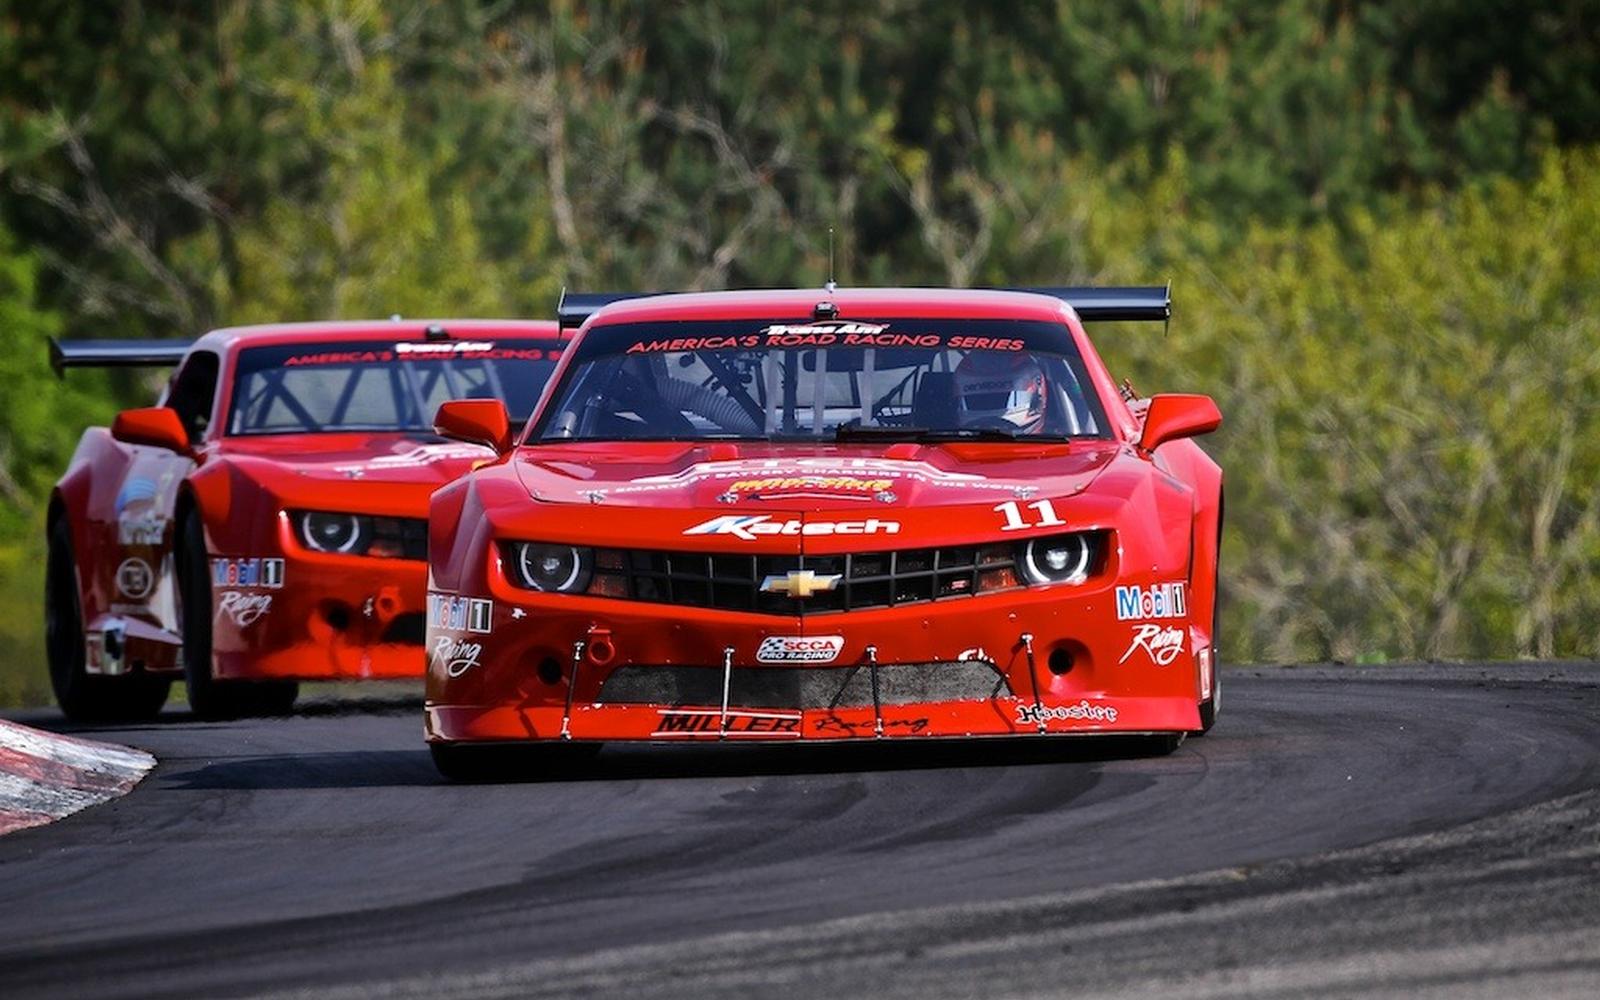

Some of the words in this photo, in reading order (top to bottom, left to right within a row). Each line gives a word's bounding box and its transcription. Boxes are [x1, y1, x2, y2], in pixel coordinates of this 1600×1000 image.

[766, 324, 836, 335] Trans
[836, 323, 886, 334] Am
[626, 335, 760, 353] AMERICA'S
[766, 334, 837, 347] ROAD
[843, 334, 940, 347] RACING
[947, 335, 1025, 351] SERIES
[994, 498, 1066, 531] 11
[683, 514, 900, 541] Katech
[1116, 584, 1172, 620] Mobil
[784, 640, 836, 651] SCCA
[761, 651, 785, 659] PRO
[786, 651, 834, 660] RACING
[657, 713, 799, 732] MILLER
